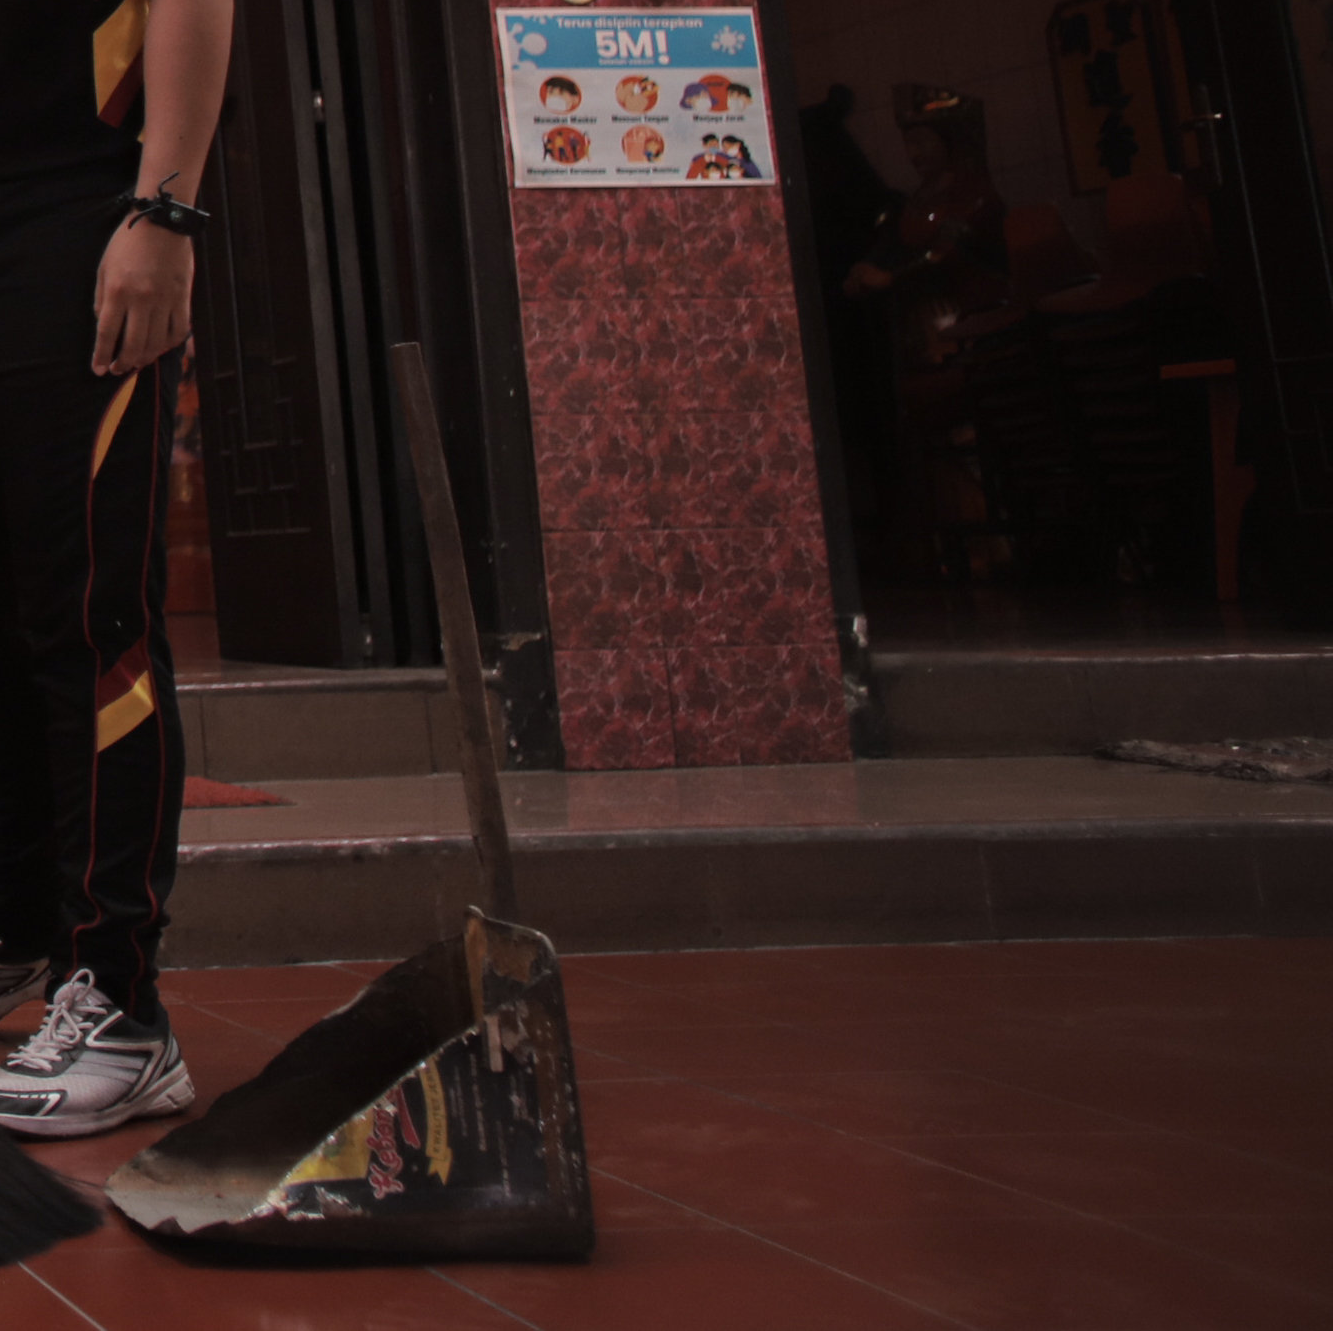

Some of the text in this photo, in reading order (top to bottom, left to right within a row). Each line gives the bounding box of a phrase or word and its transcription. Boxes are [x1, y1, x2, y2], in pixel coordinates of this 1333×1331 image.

[556, 17, 703, 31] Terus disiplin terapkan
[595, 30, 670, 65] 5M!
